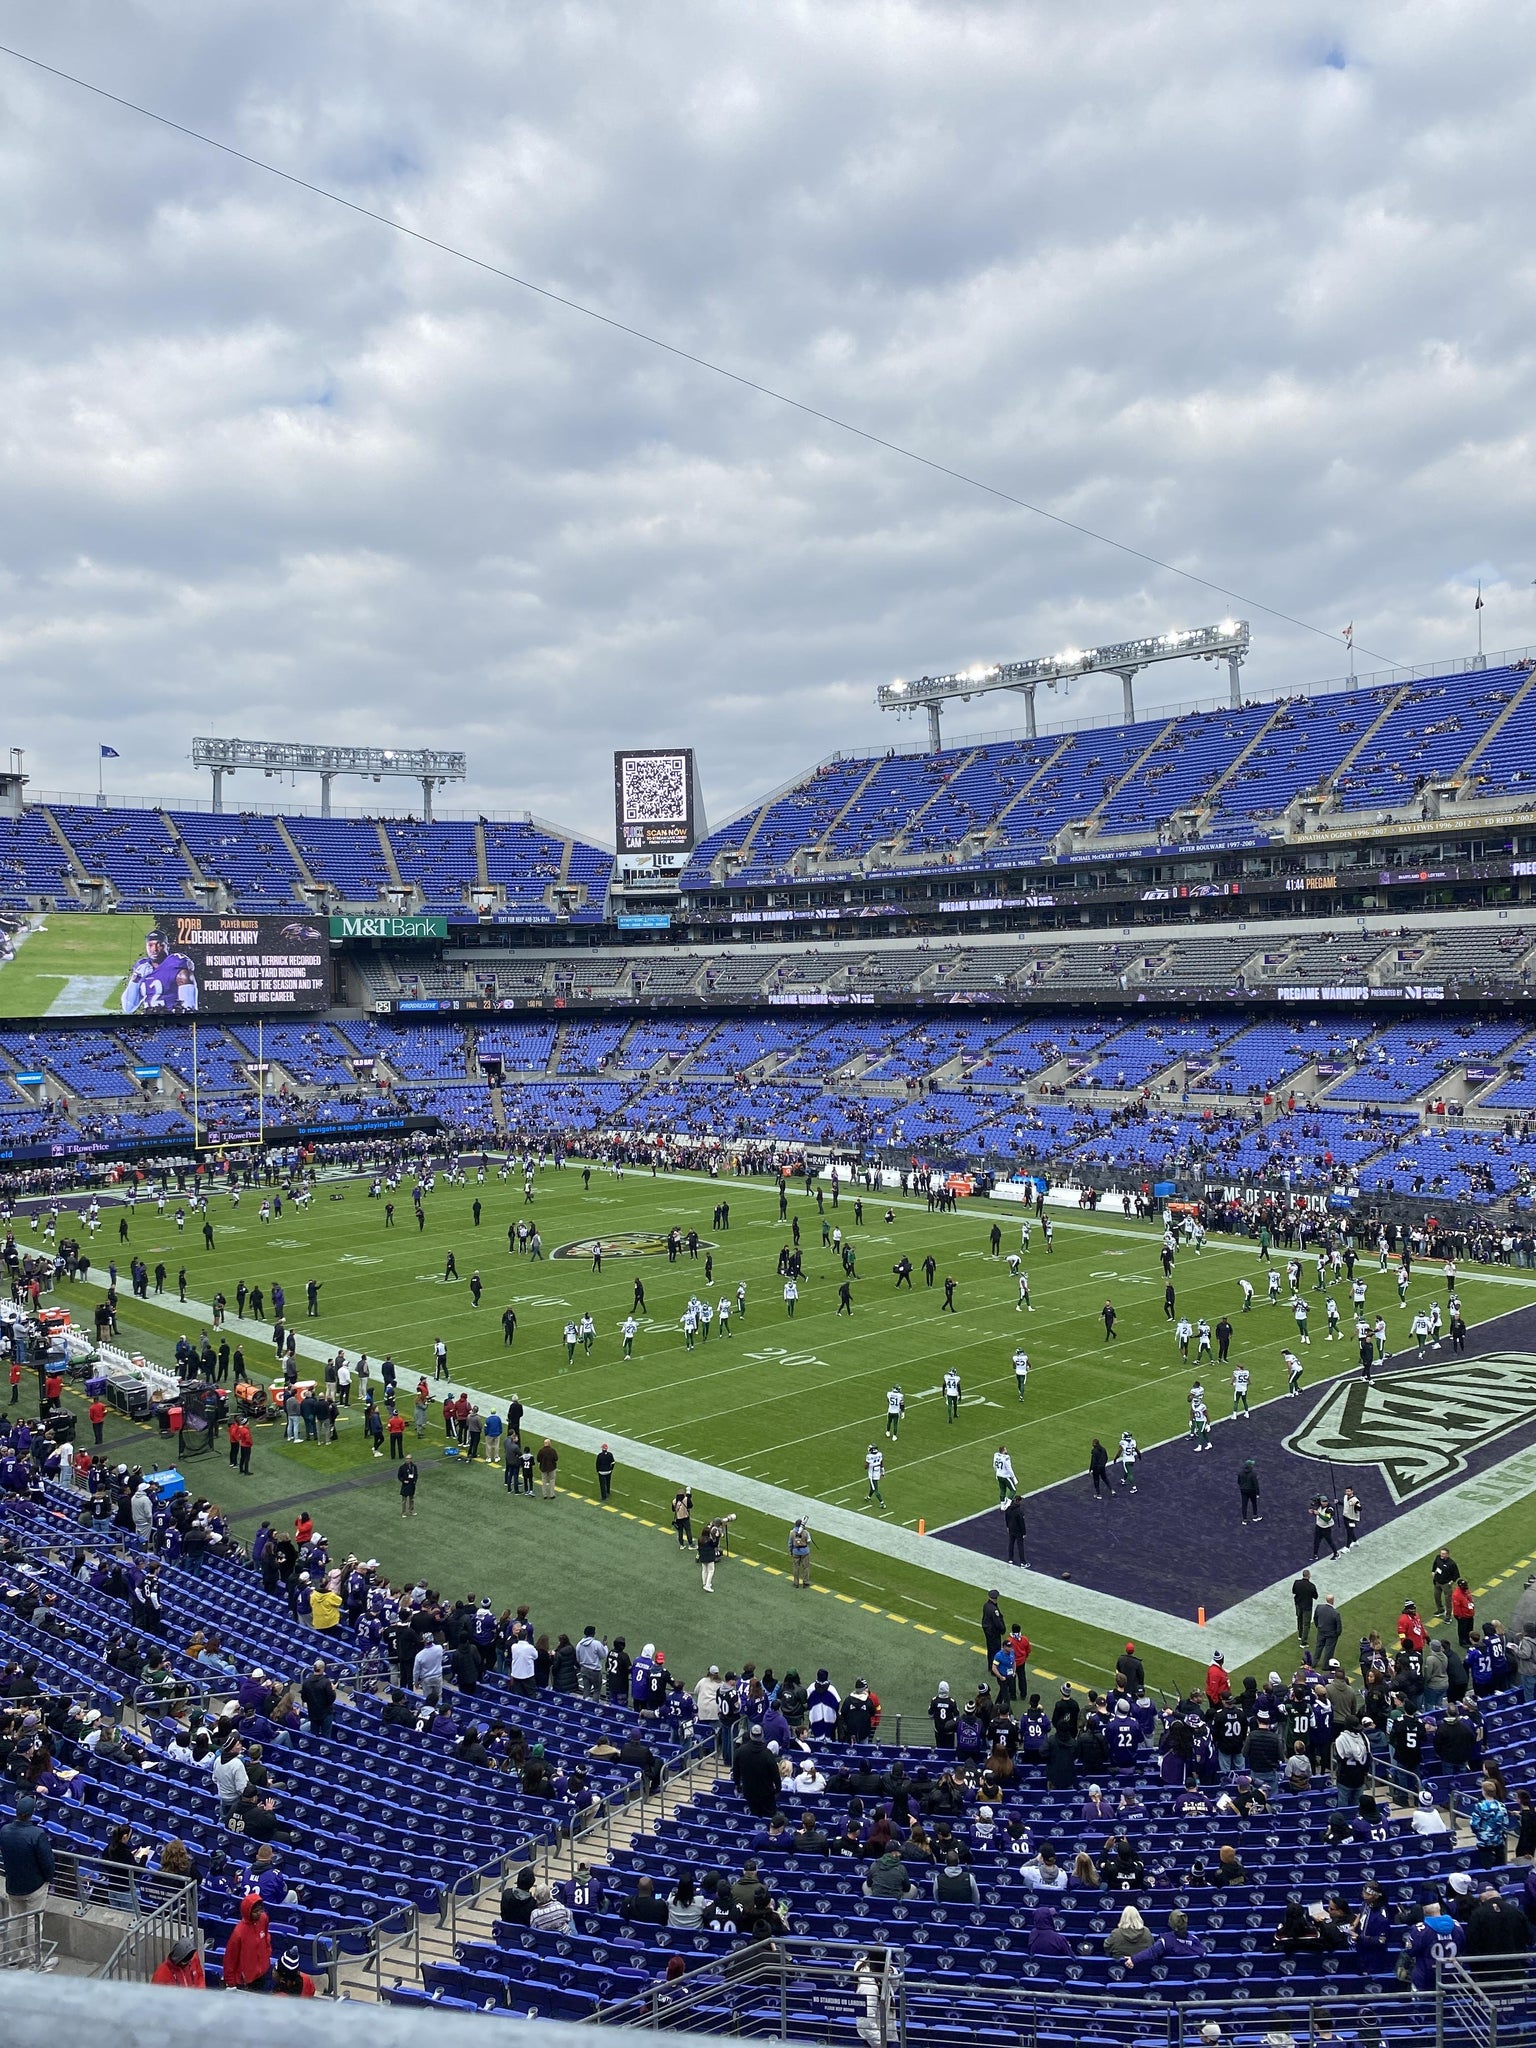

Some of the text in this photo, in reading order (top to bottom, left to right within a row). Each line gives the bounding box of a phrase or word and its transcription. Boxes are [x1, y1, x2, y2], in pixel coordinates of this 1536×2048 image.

[1435, 821, 1472, 829] 1996-2012
[1496, 816, 1514, 824] REED
[668, 828, 688, 836] NOW
[1297, 834, 1329, 843] JONATHAN
[1331, 831, 1352, 839] OGDEN
[1178, 845, 1195, 853] PETER
[1196, 842, 1226, 851] BOULWARE
[652, 854, 674, 867] Lite
[1285, 876, 1337, 891] 41:44 PREGAME
[1141, 888, 1169, 900] JETS
[939, 899, 1002, 912] PREGAME WARMUPS
[731, 910, 793, 922] PREGAME WARMUPS
[192, 918, 258, 929] RB PLAYER NOTES
[341, 918, 437, 936] M&T Bank
[177, 917, 191, 944] 22
[191, 931, 259, 944] DERRICK HENRY
[206, 956, 321, 967] IN SUNDAY'S WIN, DERRICK RECORDED
[222, 968, 306, 978] HIS 4TH 100-YARD RUSHING
[204, 980, 251, 991] PERFORMANCE
[252, 980, 260, 990] OF
[260, 980, 274, 990] THE
[274, 979, 298, 990] SEASON
[298, 979, 311, 989] AND
[234, 993, 249, 1003] 51ST
[249, 993, 259, 1002] OF
[259, 992, 270, 1002] HIS
[769, 995, 798, 1004] PREGAME
[798, 994, 828, 1004] WARMUPS
[1277, 987, 1319, 1000] PREGAME
[1321, 986, 1369, 1000] WARMUPS
[1371, 989, 1396, 997] PRESENTED
[453, 1001, 459, 1009] 19
[299, 1126, 307, 1134] to
[307, 1124, 336, 1134] navigate
[343, 1123, 362, 1132] tough
[363, 1121, 388, 1131] playing
[389, 1120, 404, 1128] field
[1205, 1185, 1241, 1203] HME
[1246, 1189, 1260, 1204] OF
[1290, 1193, 1328, 1213] FOCK
[742, 1347, 817, 1366] 20
[947, 1380, 956, 1389] 44
[890, 1397, 899, 1406] 51
[8, 1464, 12, 1472] 8
[158, 1518, 163, 1526] 8
[166, 1539, 171, 1548] 8
[144, 1584, 150, 1597] 8
[358, 1624, 370, 1638] 52
[1493, 1644, 1503, 1657] 89
[1479, 1656, 1492, 1672] 52
[636, 1669, 643, 1681] 8
[651, 1678, 658, 1691] 8
[738, 1685, 749, 1696] 44
[757, 1703, 762, 1713] 8
[940, 1708, 946, 1719] 8
[1294, 1716, 1309, 1733] 10
[1325, 1714, 1330, 1728] 4
[1224, 1721, 1241, 1736] 20
[1000, 1735, 1006, 1746] 8
[1118, 1734, 1132, 1747] 22
[1407, 1733, 1417, 1748] 5
[228, 1819, 245, 1833] 92
[574, 1888, 590, 1905] 81
[820, 1996, 840, 2005] STANDING
[848, 1999, 866, 2007] LANDING
